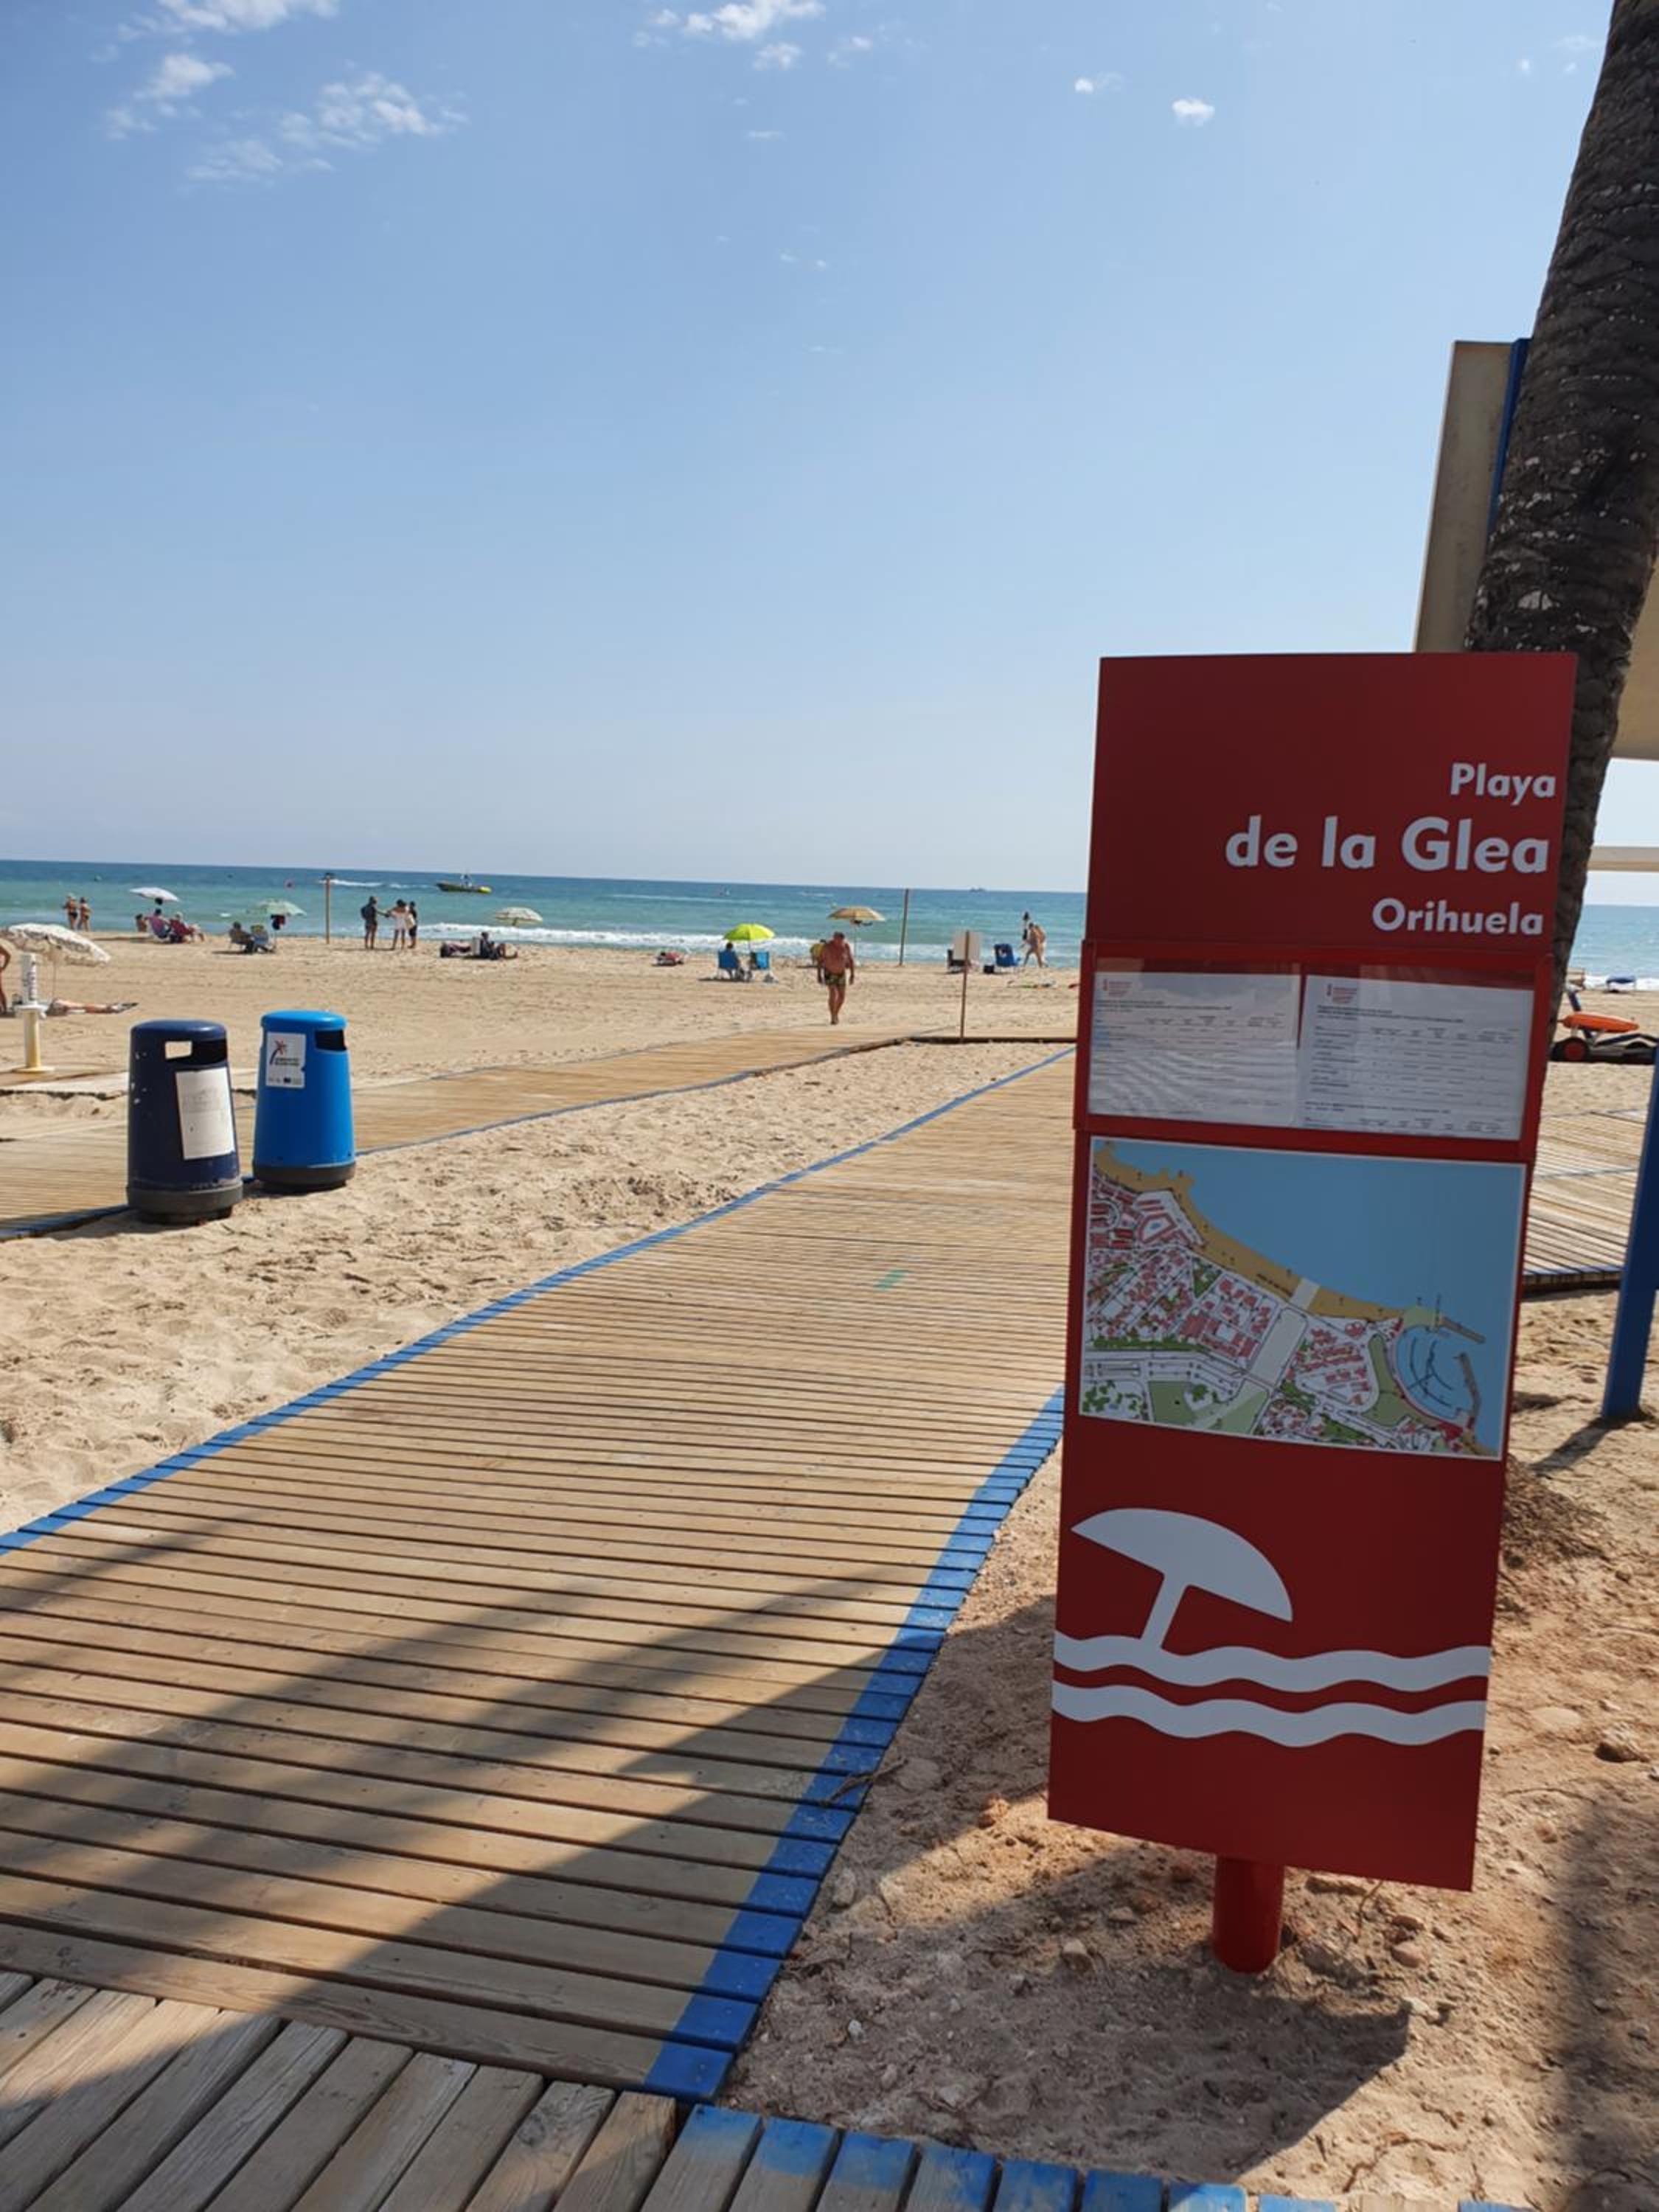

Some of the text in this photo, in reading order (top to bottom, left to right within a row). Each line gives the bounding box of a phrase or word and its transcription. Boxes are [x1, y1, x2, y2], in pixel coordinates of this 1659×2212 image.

[1450, 762, 1556, 806] Playa
[1225, 815, 1549, 874] de la Glea
[1372, 897, 1543, 935] Orihuela
